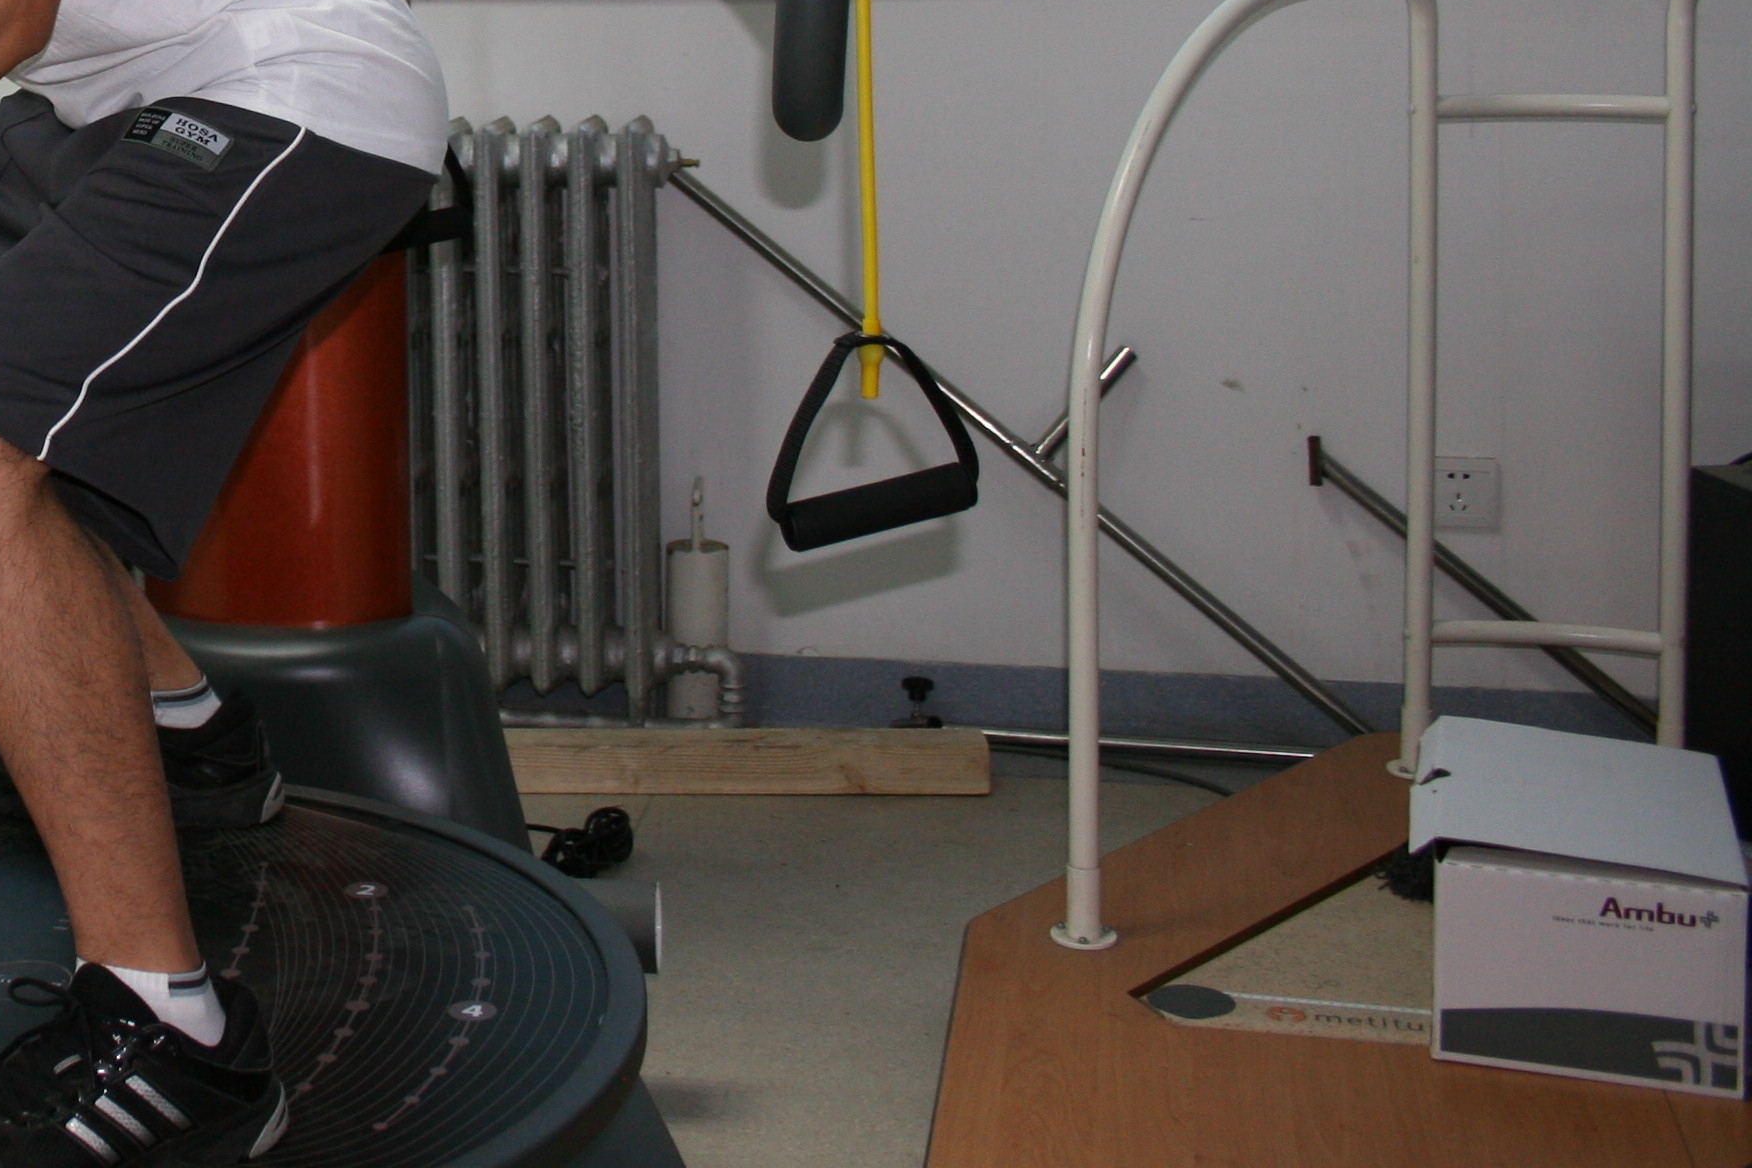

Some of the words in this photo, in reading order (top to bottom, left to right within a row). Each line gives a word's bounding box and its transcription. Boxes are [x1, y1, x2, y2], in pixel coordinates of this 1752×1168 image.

[174, 126, 211, 146] GYM
[176, 118, 219, 143] HOSA
[356, 884, 376, 896] 2
[1599, 896, 1697, 928] Ambu
[461, 1004, 484, 1017] 4
